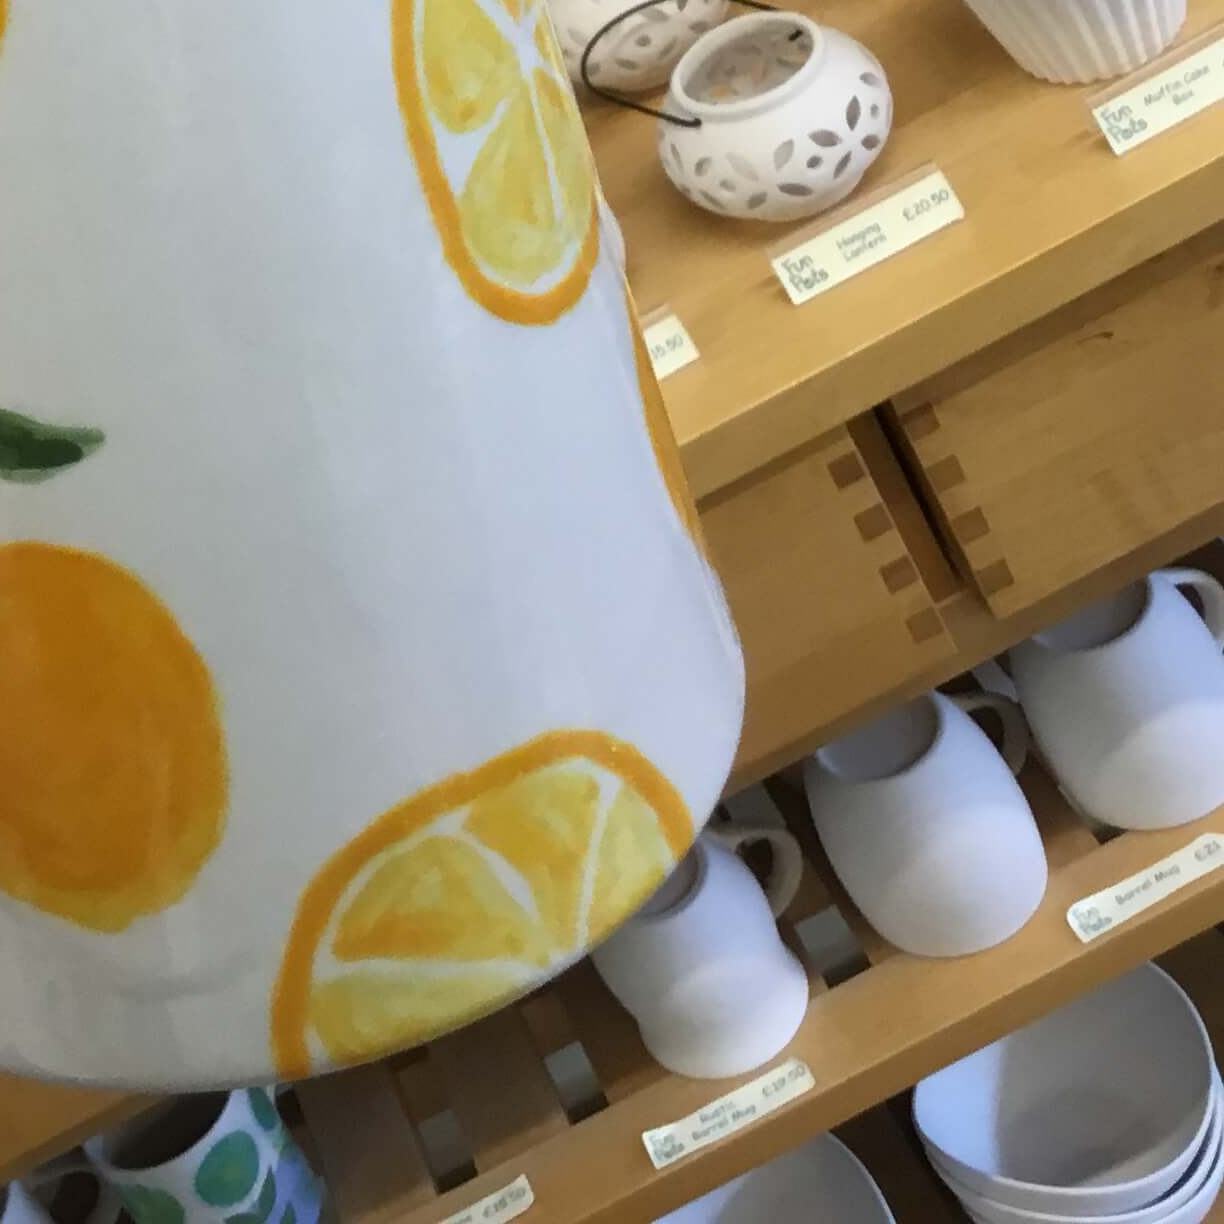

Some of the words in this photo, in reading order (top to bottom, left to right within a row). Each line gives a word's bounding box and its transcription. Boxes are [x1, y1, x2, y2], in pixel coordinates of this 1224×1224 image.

[1100, 105, 1133, 121] Fun
[1106, 118, 1148, 144] Pots
[902, 188, 950, 222] £20.50
[780, 254, 814, 274] Fun
[788, 268, 830, 293] Pots
